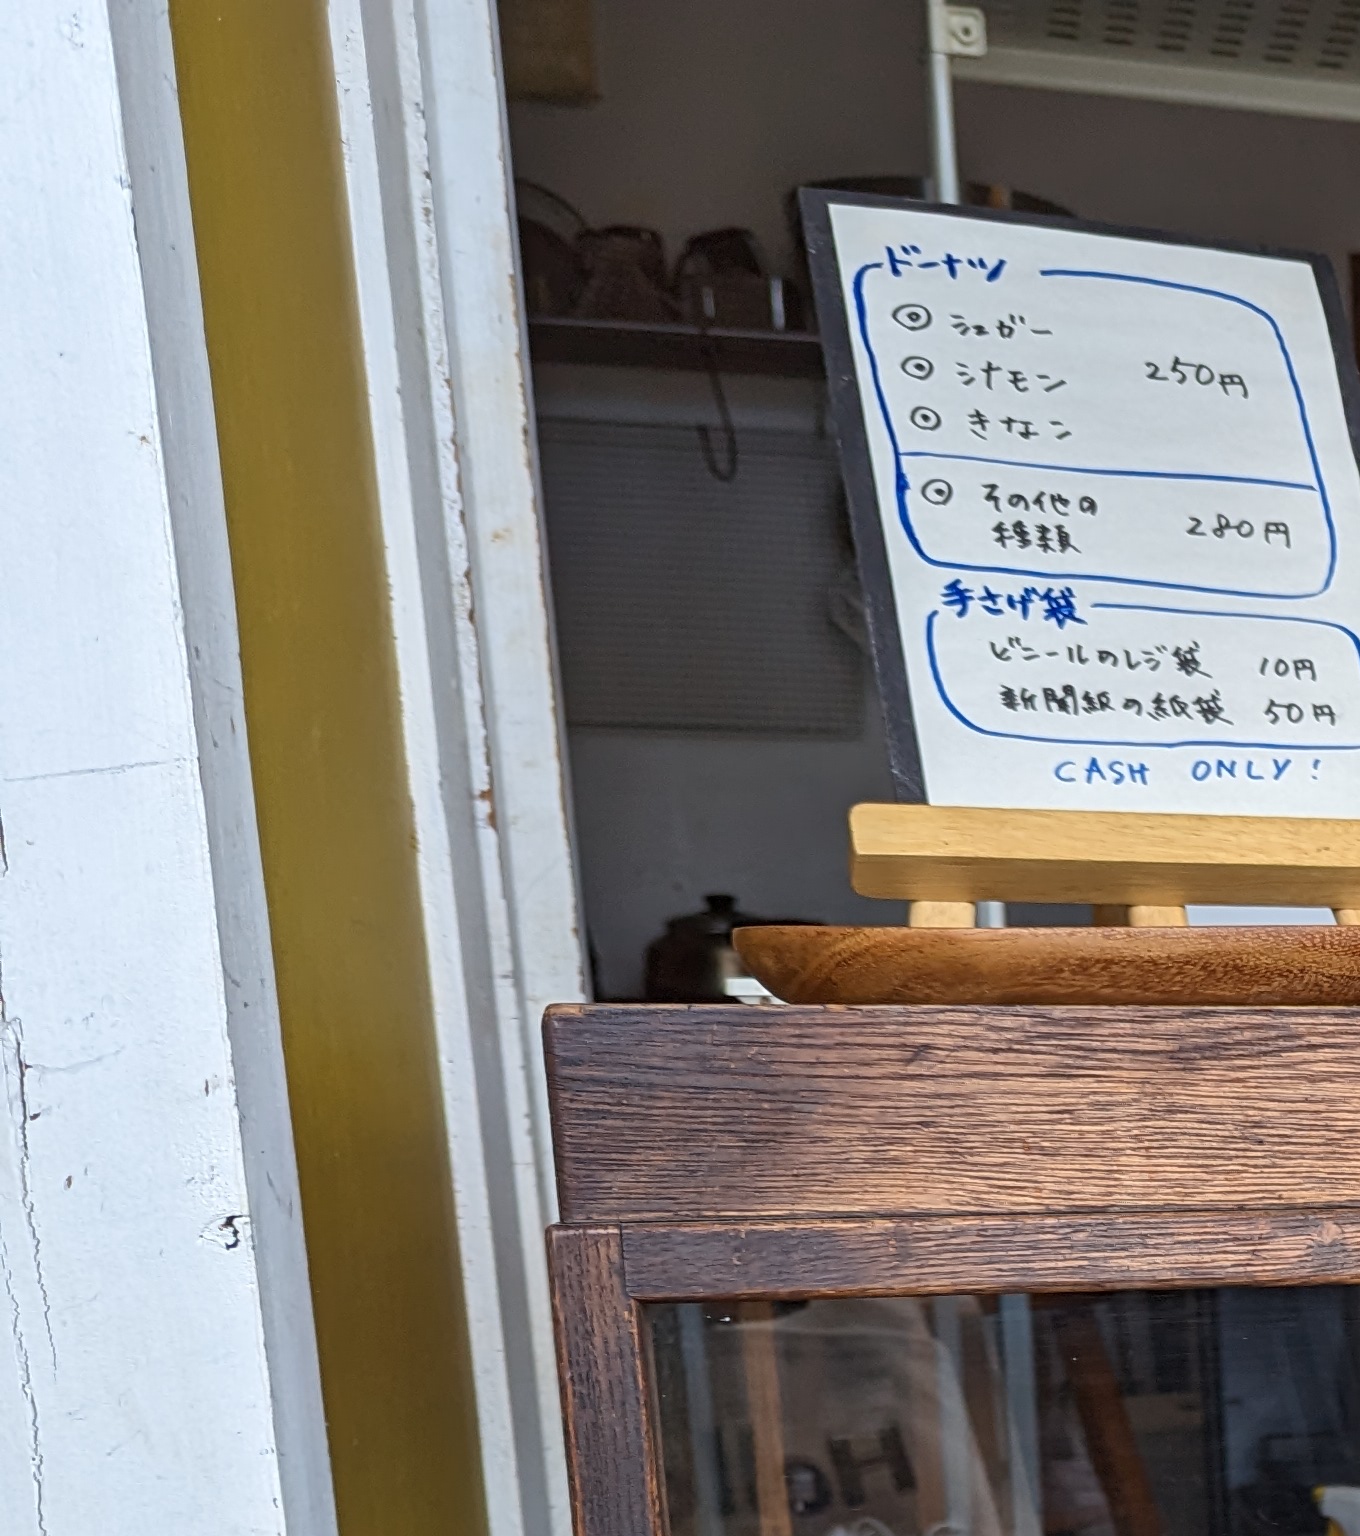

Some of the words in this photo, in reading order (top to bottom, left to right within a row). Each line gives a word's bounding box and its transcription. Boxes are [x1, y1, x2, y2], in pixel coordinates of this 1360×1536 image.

[884, 244, 1007, 283] ドーナツ
[955, 360, 1068, 393] シナモン
[1144, 355, 1249, 400] 250円
[981, 483, 1098, 517] その他の
[992, 520, 1082, 554] 種類
[1185, 513, 1291, 549] 280円
[940, 577, 1087, 630] 手さげ袋
[989, 636, 1213, 679] ビニールのレジ袋
[1259, 657, 1317, 682] 10円
[999, 683, 1234, 726] 新聞紙の紙袋
[1263, 698, 1337, 727] 50円
[1053, 756, 1150, 786] CASH
